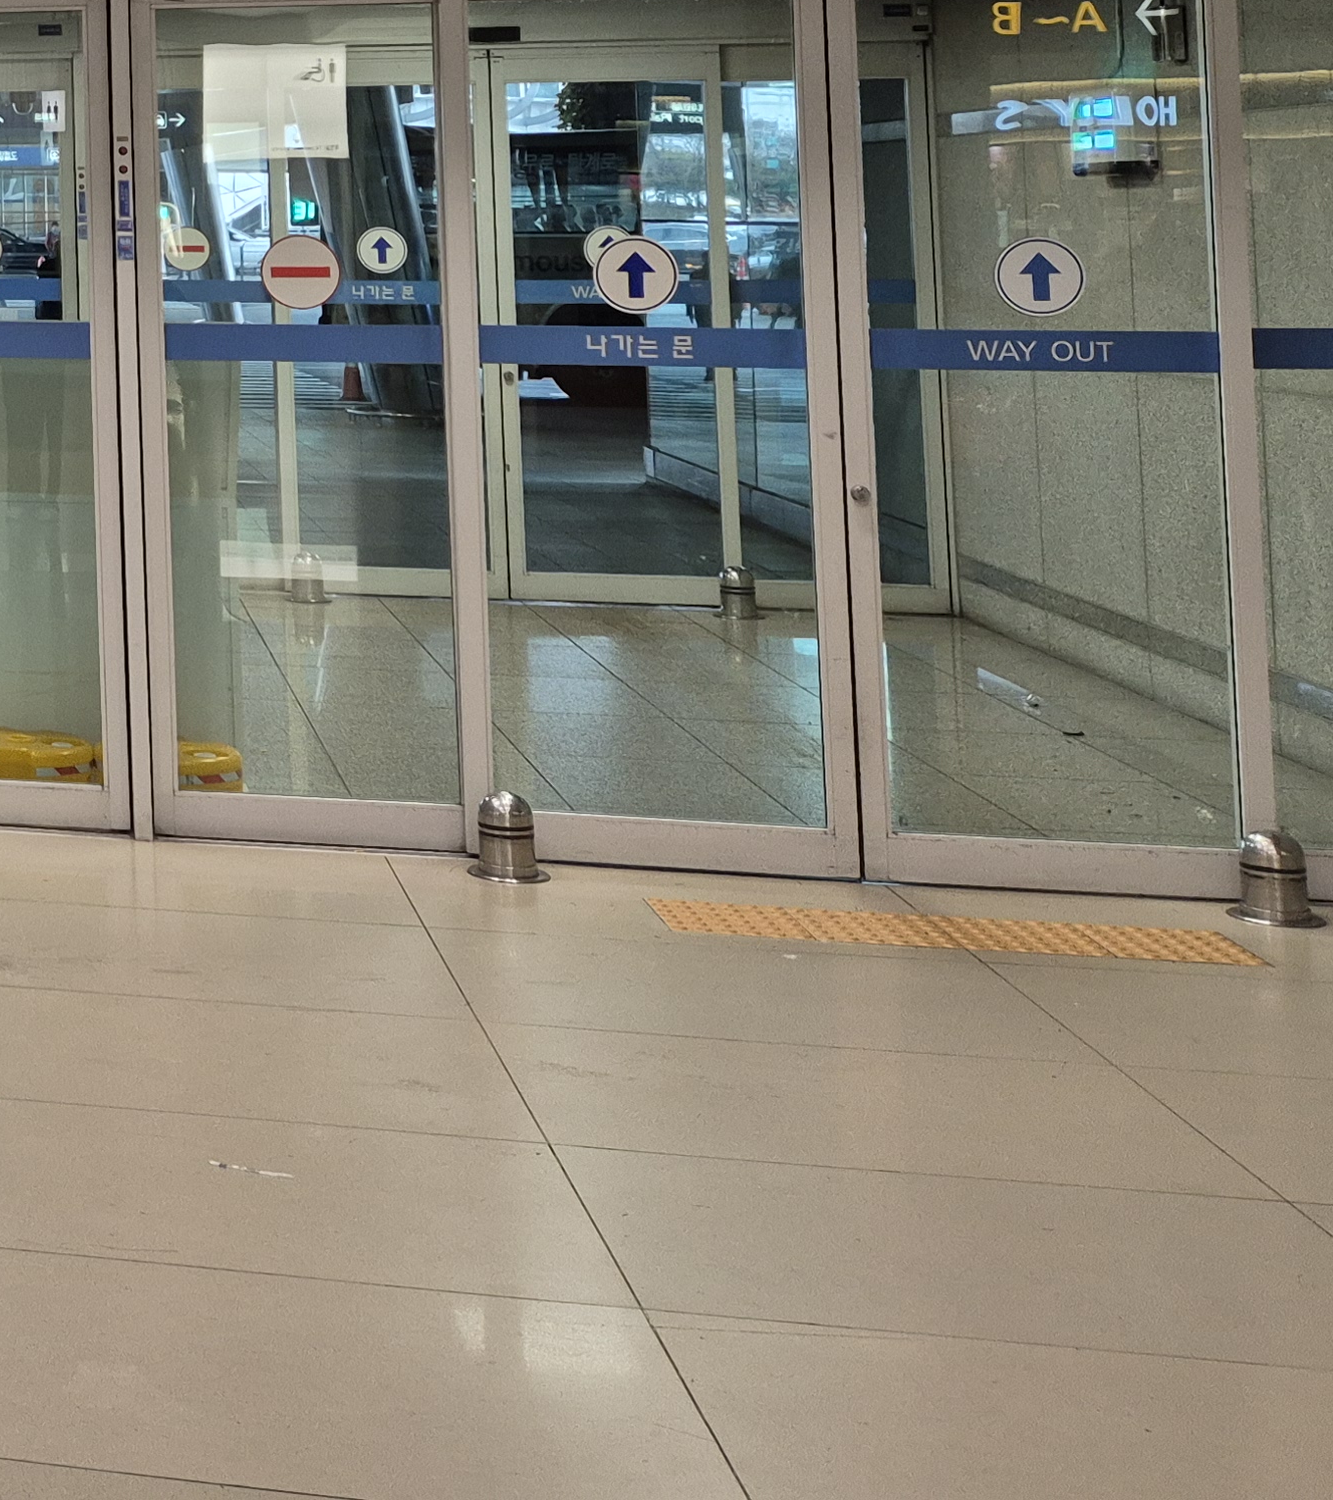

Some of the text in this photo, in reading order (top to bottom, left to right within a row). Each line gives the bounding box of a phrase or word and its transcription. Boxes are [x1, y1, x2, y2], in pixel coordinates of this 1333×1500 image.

[571, 284, 599, 298] WA
[585, 334, 695, 359] 나가는 문
[966, 340, 1115, 362] WAY OUT
